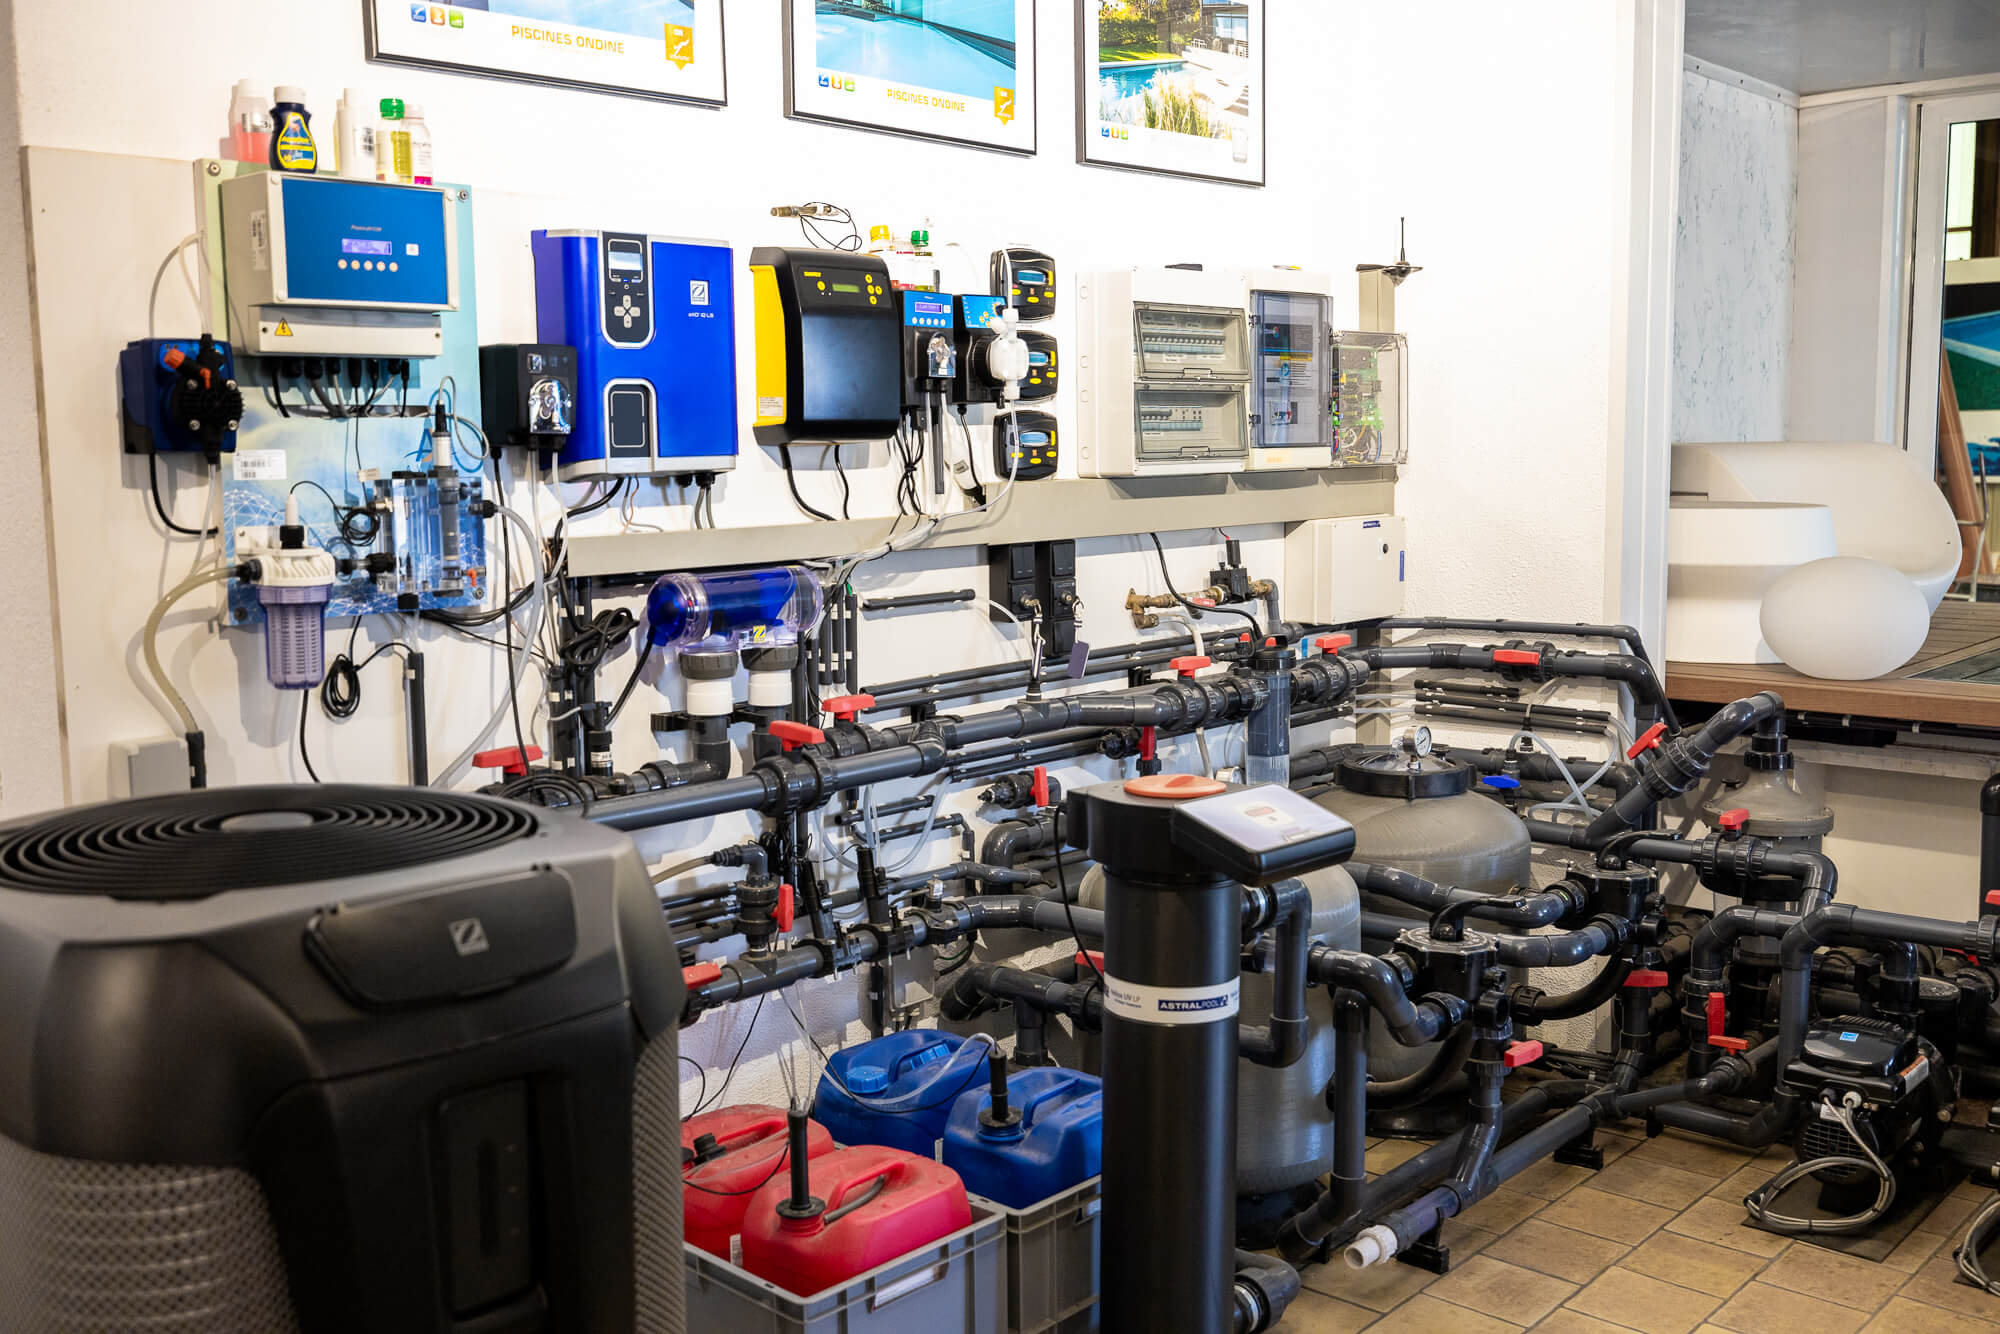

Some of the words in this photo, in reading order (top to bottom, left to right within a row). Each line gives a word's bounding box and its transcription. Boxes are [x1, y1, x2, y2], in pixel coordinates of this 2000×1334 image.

[511, 25, 573, 46] PISCINES
[576, 35, 625, 54] ONDINE
[887, 88, 929, 105] PISCINES
[931, 96, 966, 112] ONDINE
